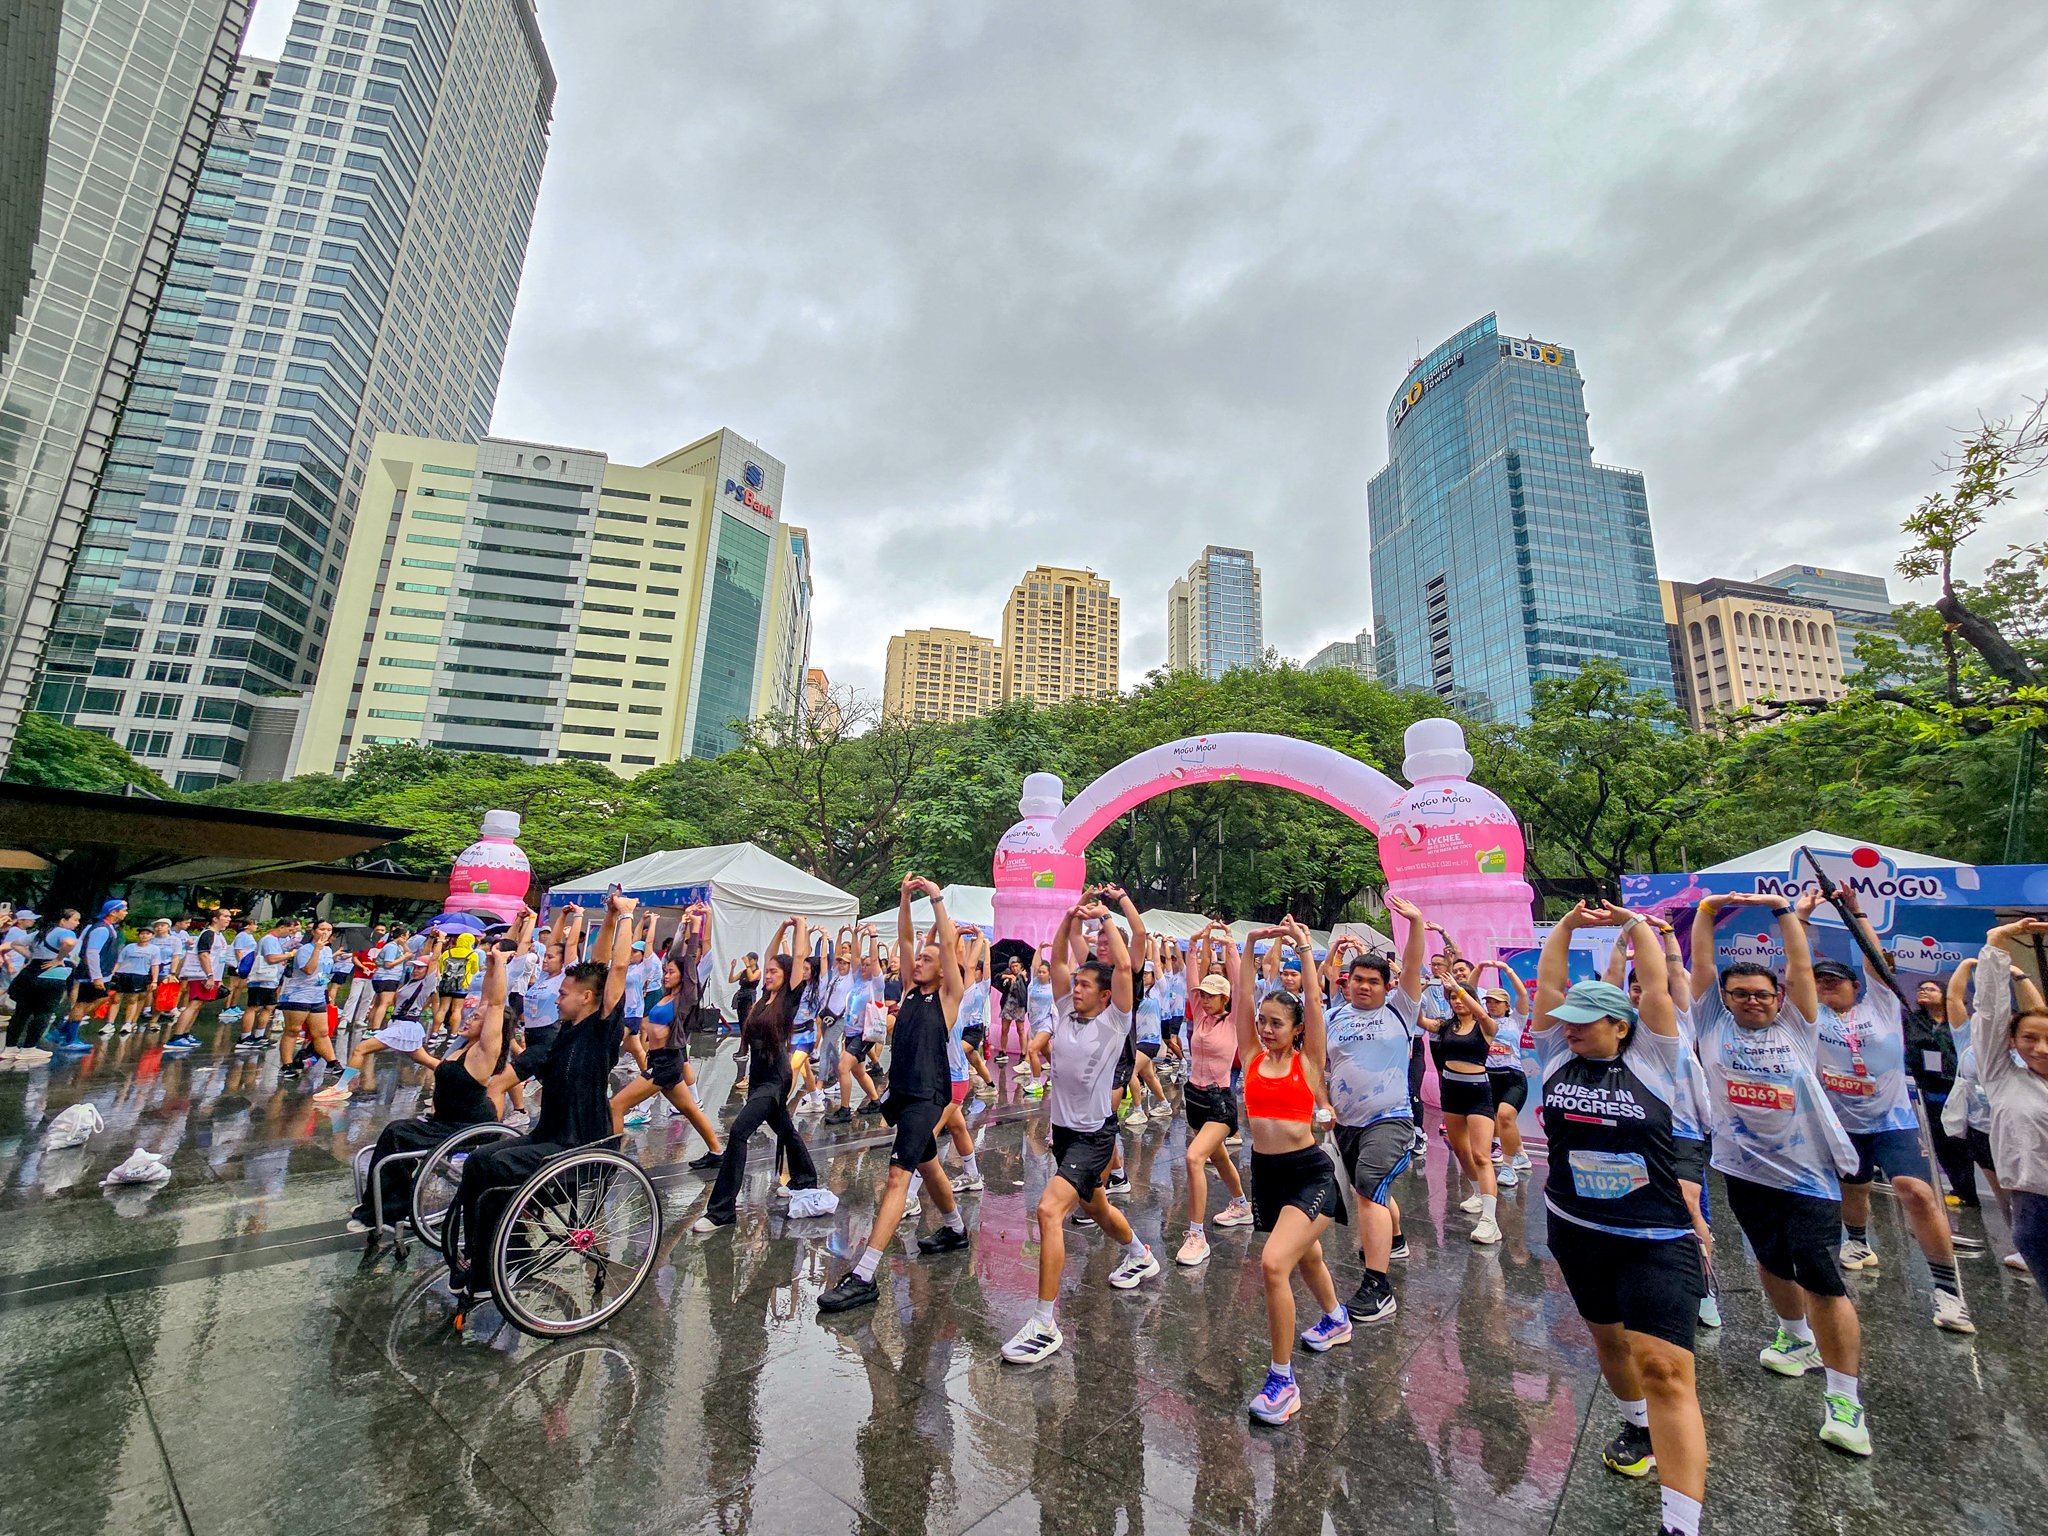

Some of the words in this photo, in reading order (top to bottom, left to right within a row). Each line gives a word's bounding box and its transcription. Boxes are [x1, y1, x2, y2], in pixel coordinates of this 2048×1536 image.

[1510, 338, 1562, 366] BDO
[1423, 352, 1463, 384] Equitable
[1424, 368, 1452, 391] Tower
[1393, 382, 1423, 430] BDO
[725, 479, 774, 520] PSBank
[1411, 798, 1439, 811] MOGU
[1442, 795, 1472, 804] MOGU
[1427, 833, 1462, 846] LYCHEE
[1758, 878, 1817, 898] MOG
[1720, 946, 1752, 956] MOGU
[1756, 946, 1785, 956] MOG
[1920, 949, 1961, 960] MOGU
[1339, 1033, 1364, 1042] turns
[1366, 1033, 1375, 1041] 3!
[1744, 1045, 1791, 1055] CAR-FREE
[1732, 1060, 1770, 1074] turns
[1773, 1064, 1786, 1074] 3!
[1824, 1076, 1861, 1091] 60607
[1553, 1082, 1611, 1101] QUEST
[1615, 1088, 1635, 1104] IN
[1729, 1085, 1777, 1102] 60369
[1545, 1094, 1647, 1120] PROGRESS
[1575, 1174, 1630, 1192] 31029
